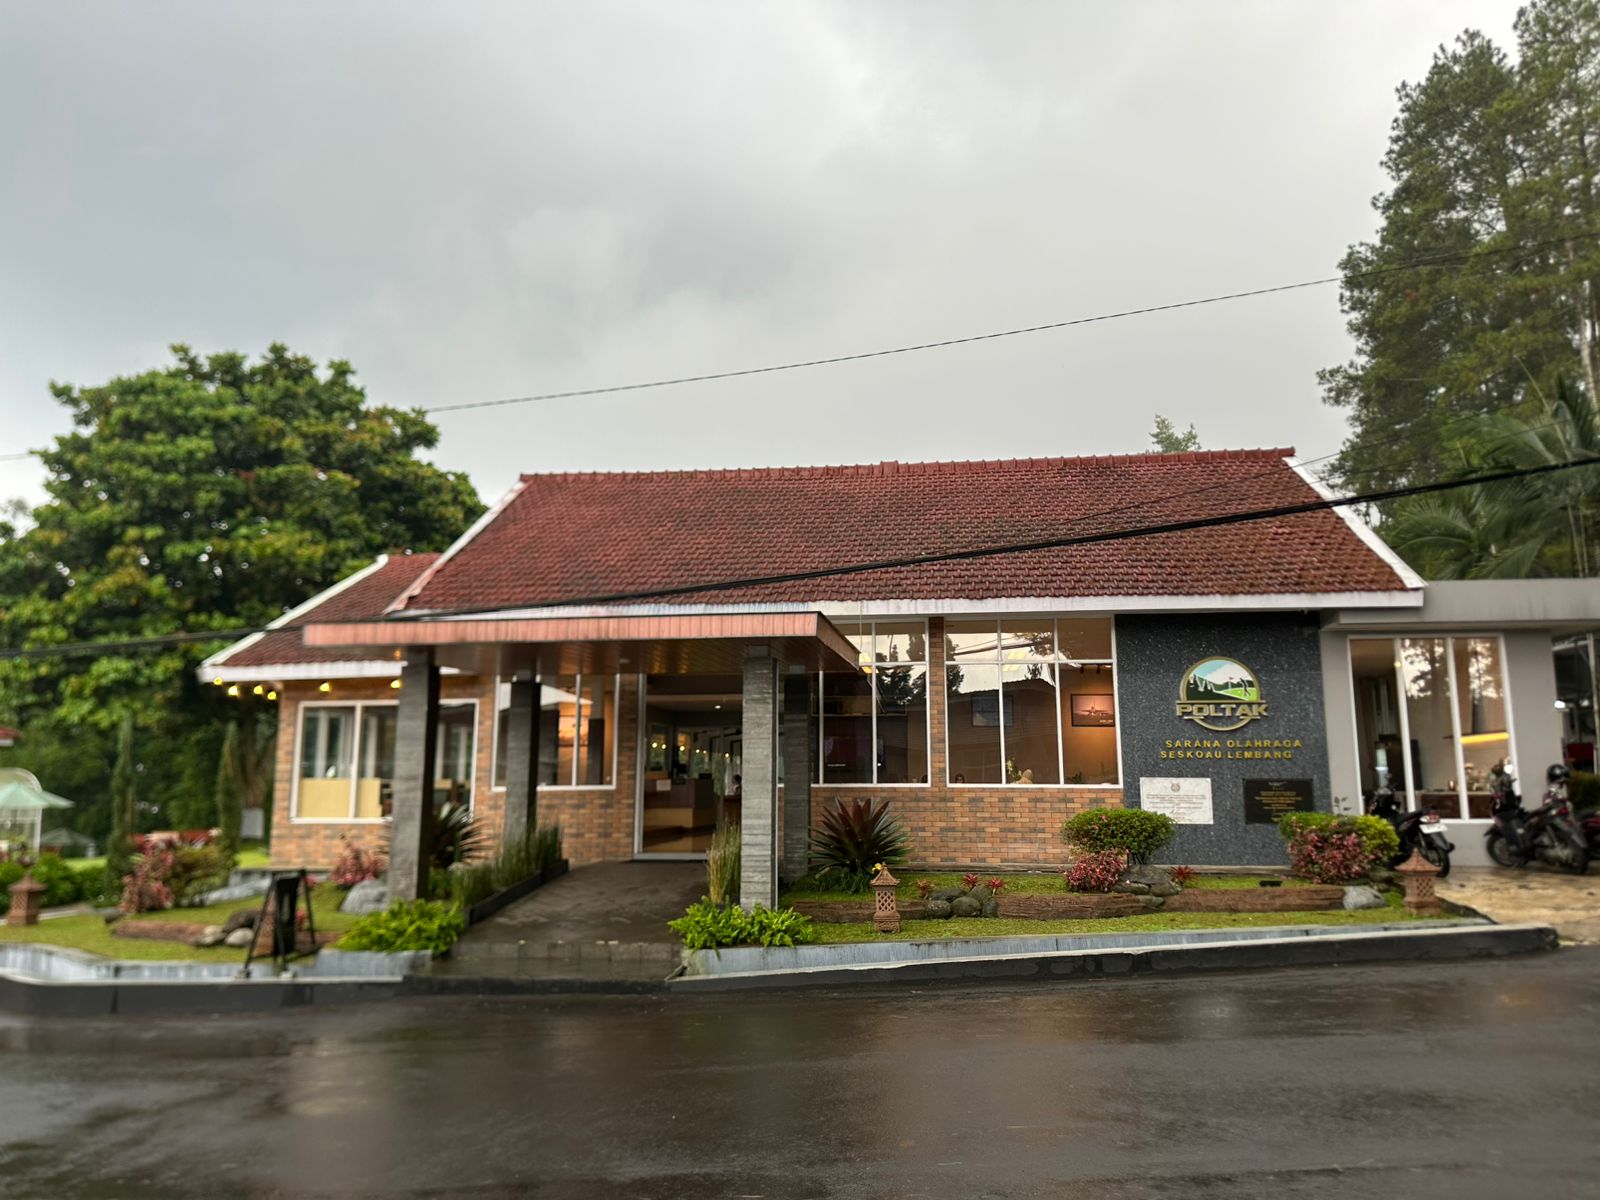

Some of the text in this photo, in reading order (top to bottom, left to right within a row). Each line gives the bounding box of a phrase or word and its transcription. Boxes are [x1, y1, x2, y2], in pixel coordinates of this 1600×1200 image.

[1176, 704, 1269, 716] POLTAK
[1165, 739, 1302, 748] SARANA OLAHRAGA
[1160, 750, 1292, 759] SESKOAU LEMBANG
